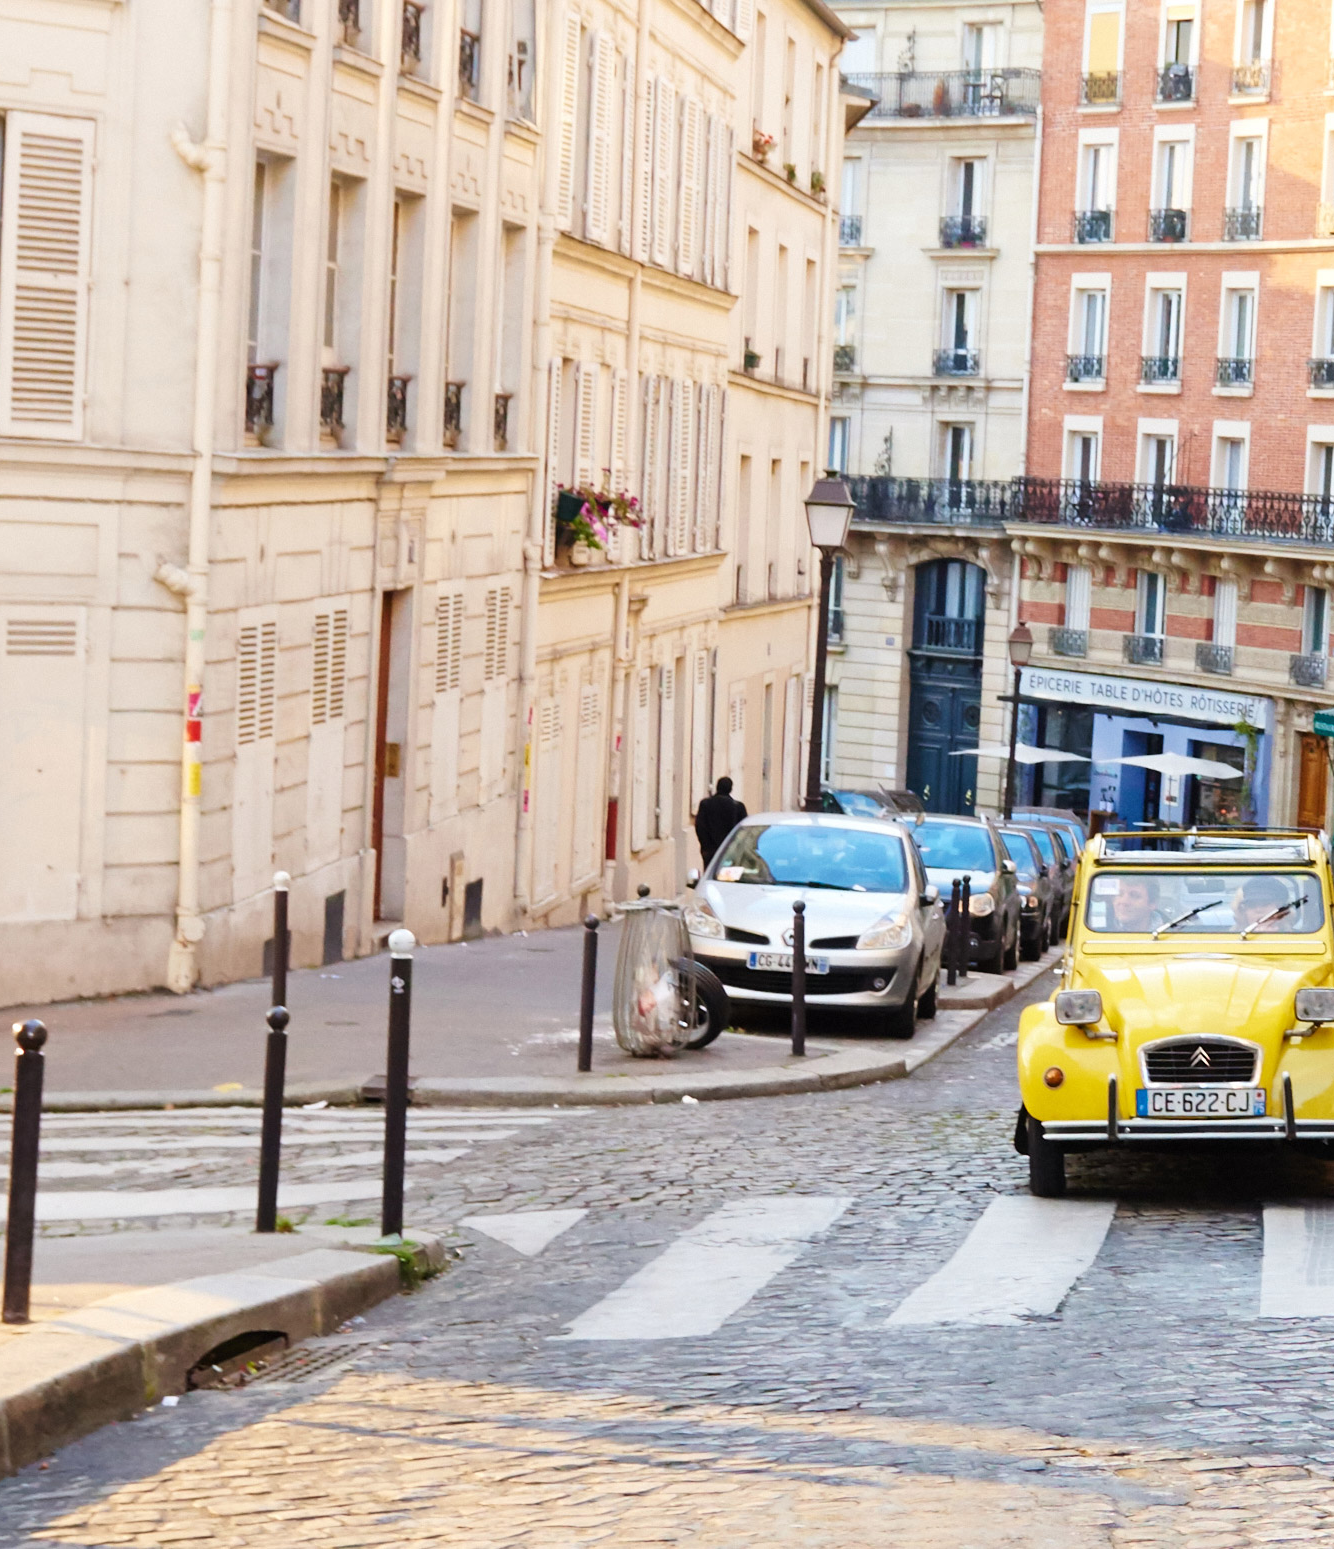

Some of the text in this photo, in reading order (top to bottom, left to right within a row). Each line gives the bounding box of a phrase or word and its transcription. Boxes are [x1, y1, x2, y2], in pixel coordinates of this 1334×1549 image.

[1029, 673, 1255, 718] ÉPICERIE TABLE D'HÔTES RÔTISSERIE
[1152, 1092, 1250, 1113] CE-622-CJ
